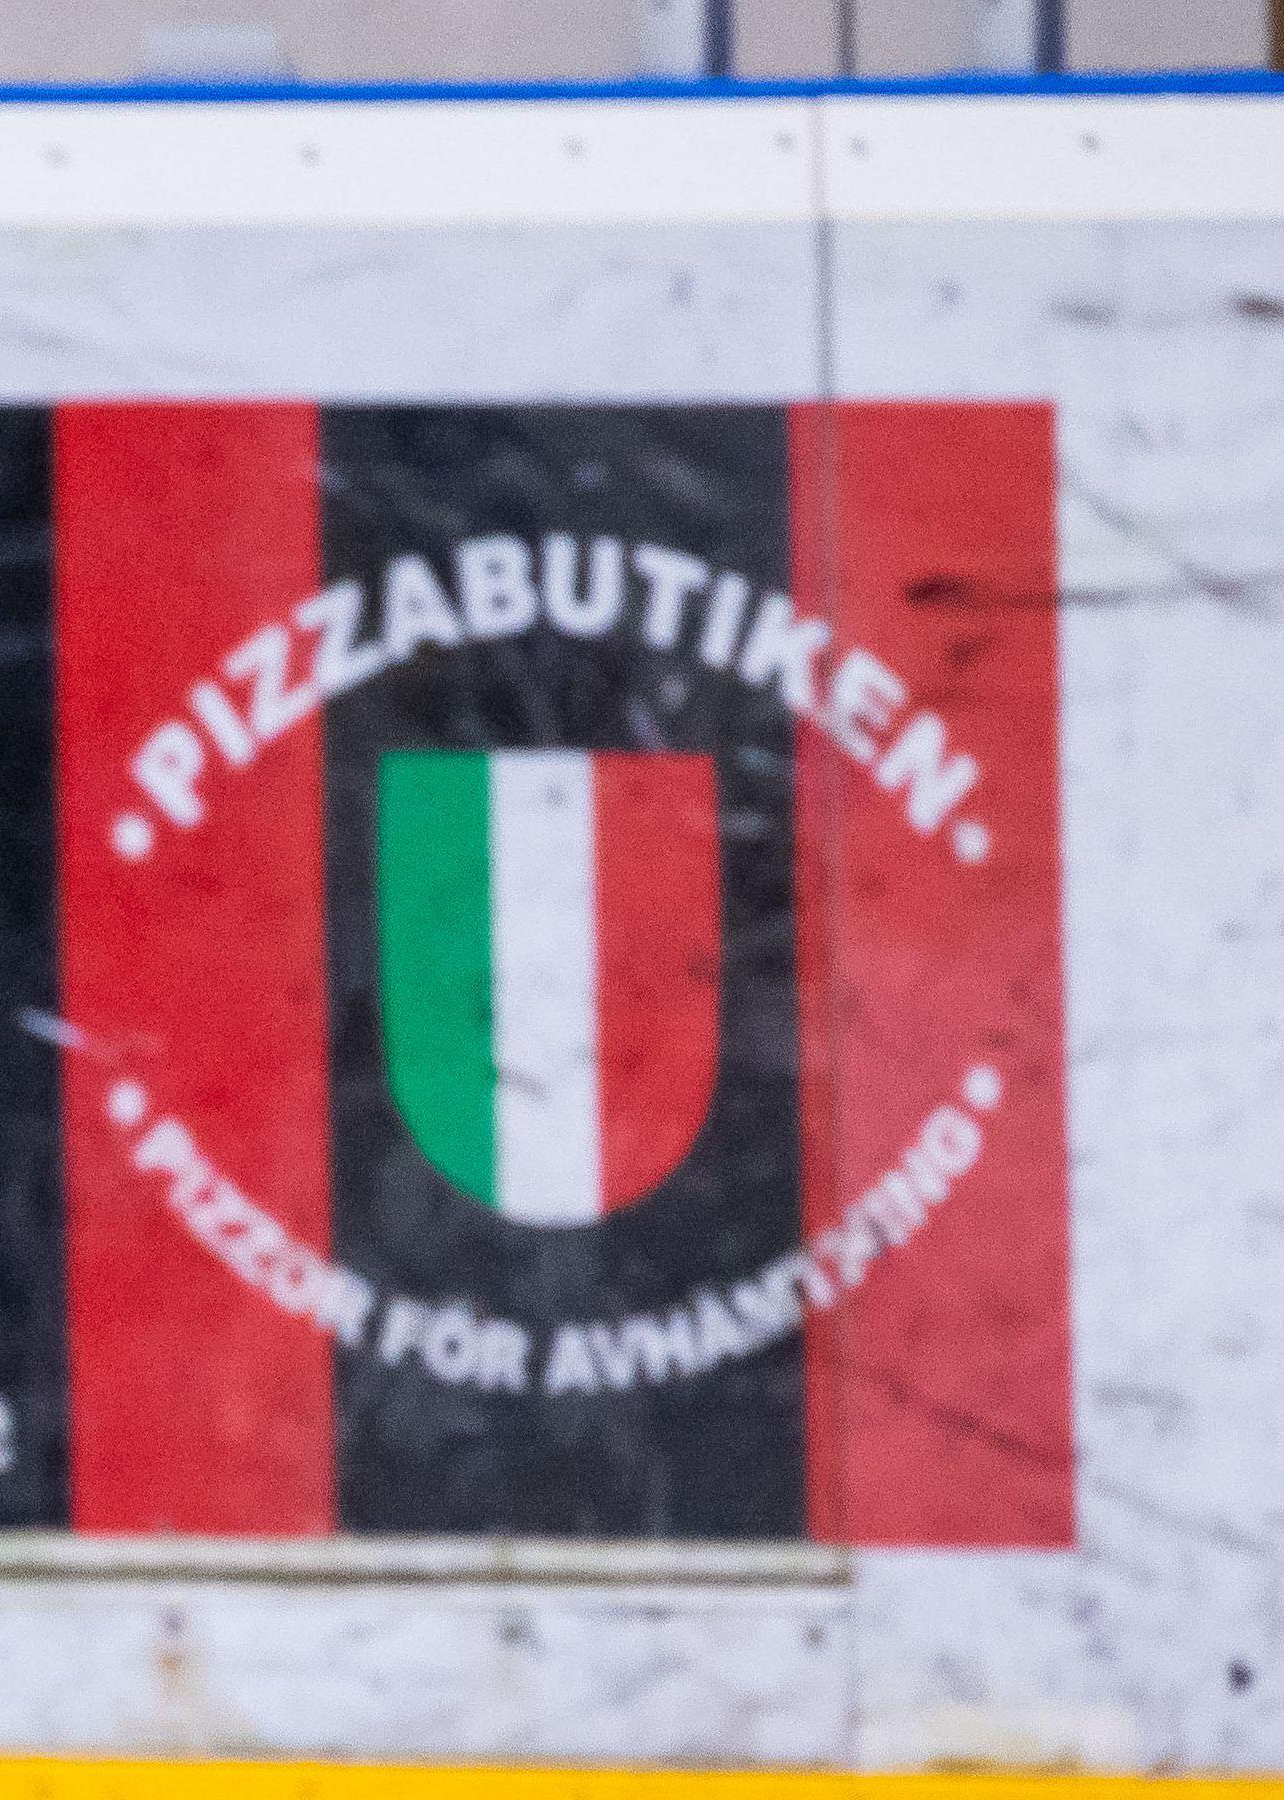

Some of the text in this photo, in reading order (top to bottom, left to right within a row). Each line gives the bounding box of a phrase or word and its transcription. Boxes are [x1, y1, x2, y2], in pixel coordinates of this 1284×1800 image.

[130, 533, 979, 834] PIZZABUTIKEN
[135, 1117, 376, 1347] PIZZOR
[379, 1298, 529, 1394] FÖR
